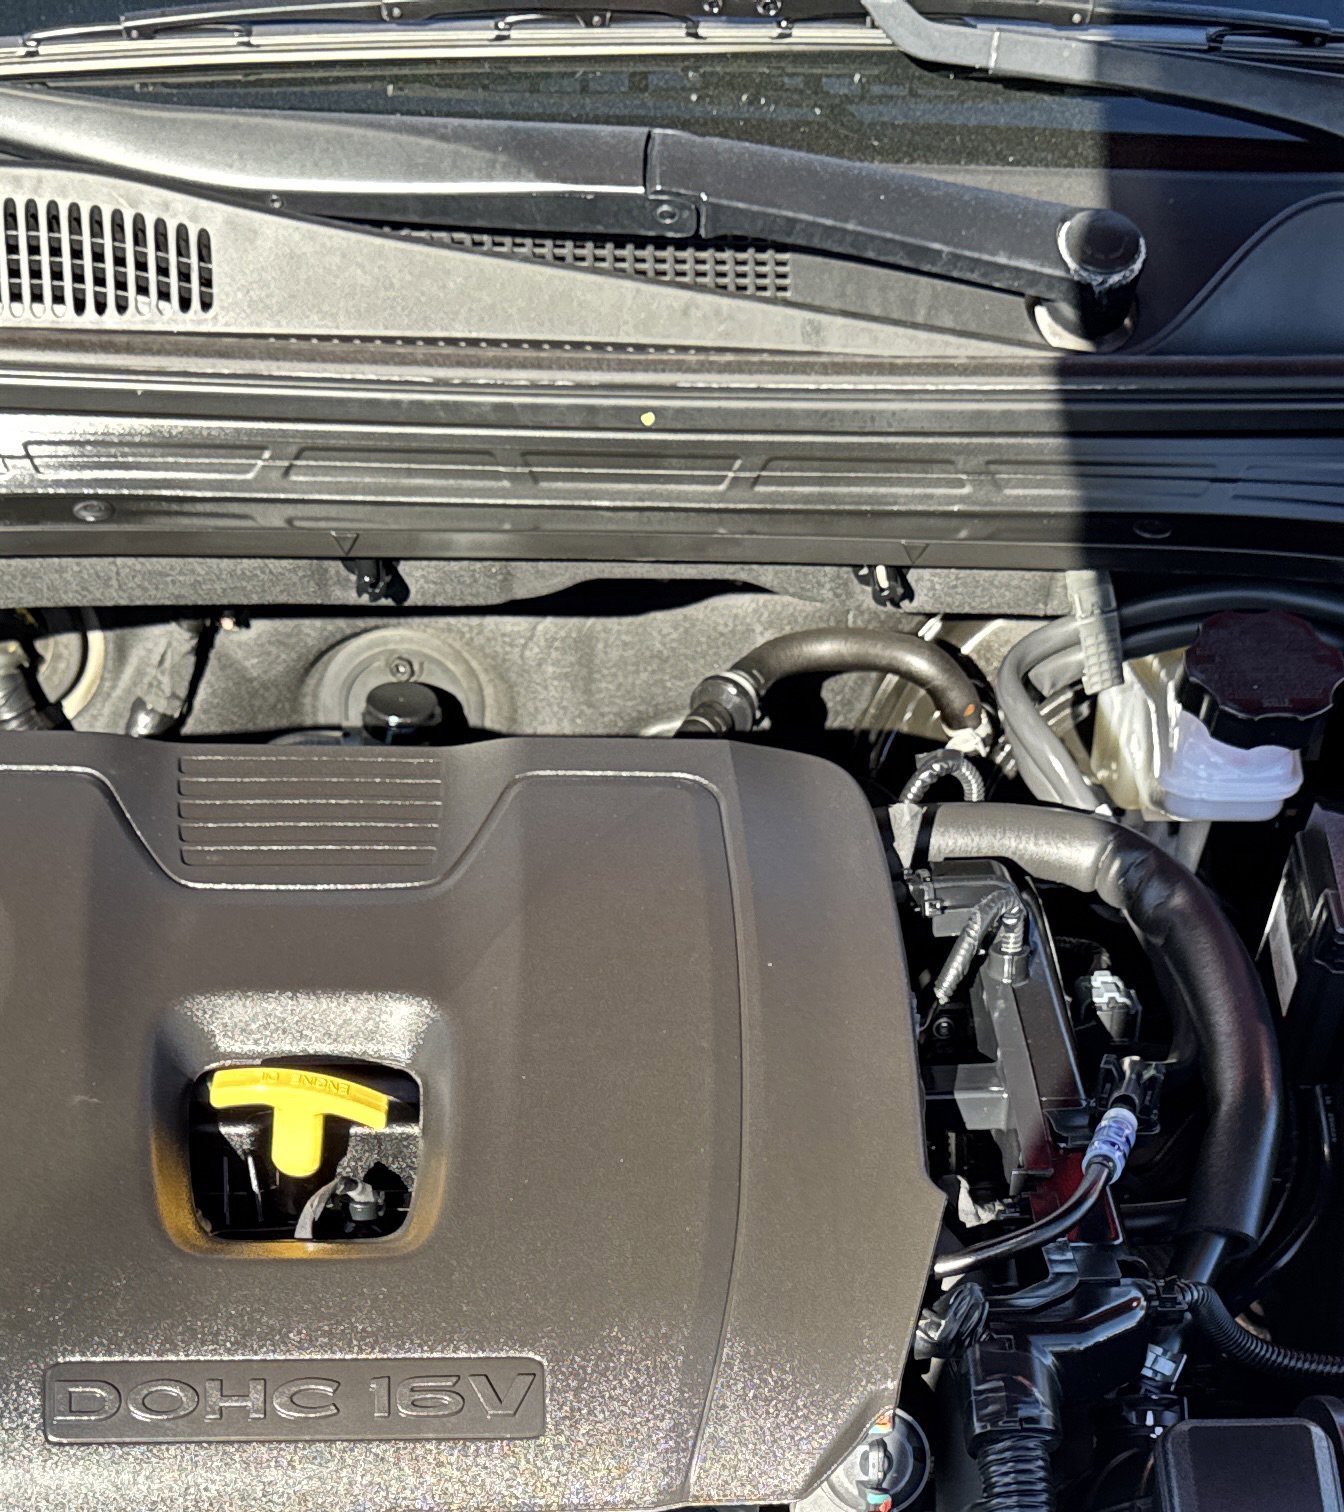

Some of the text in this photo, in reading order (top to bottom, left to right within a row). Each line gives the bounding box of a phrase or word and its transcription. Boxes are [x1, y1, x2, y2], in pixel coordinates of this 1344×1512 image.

[290, 1073, 351, 1096] ENGINE
[53, 1373, 537, 1422] DOHC 16V
